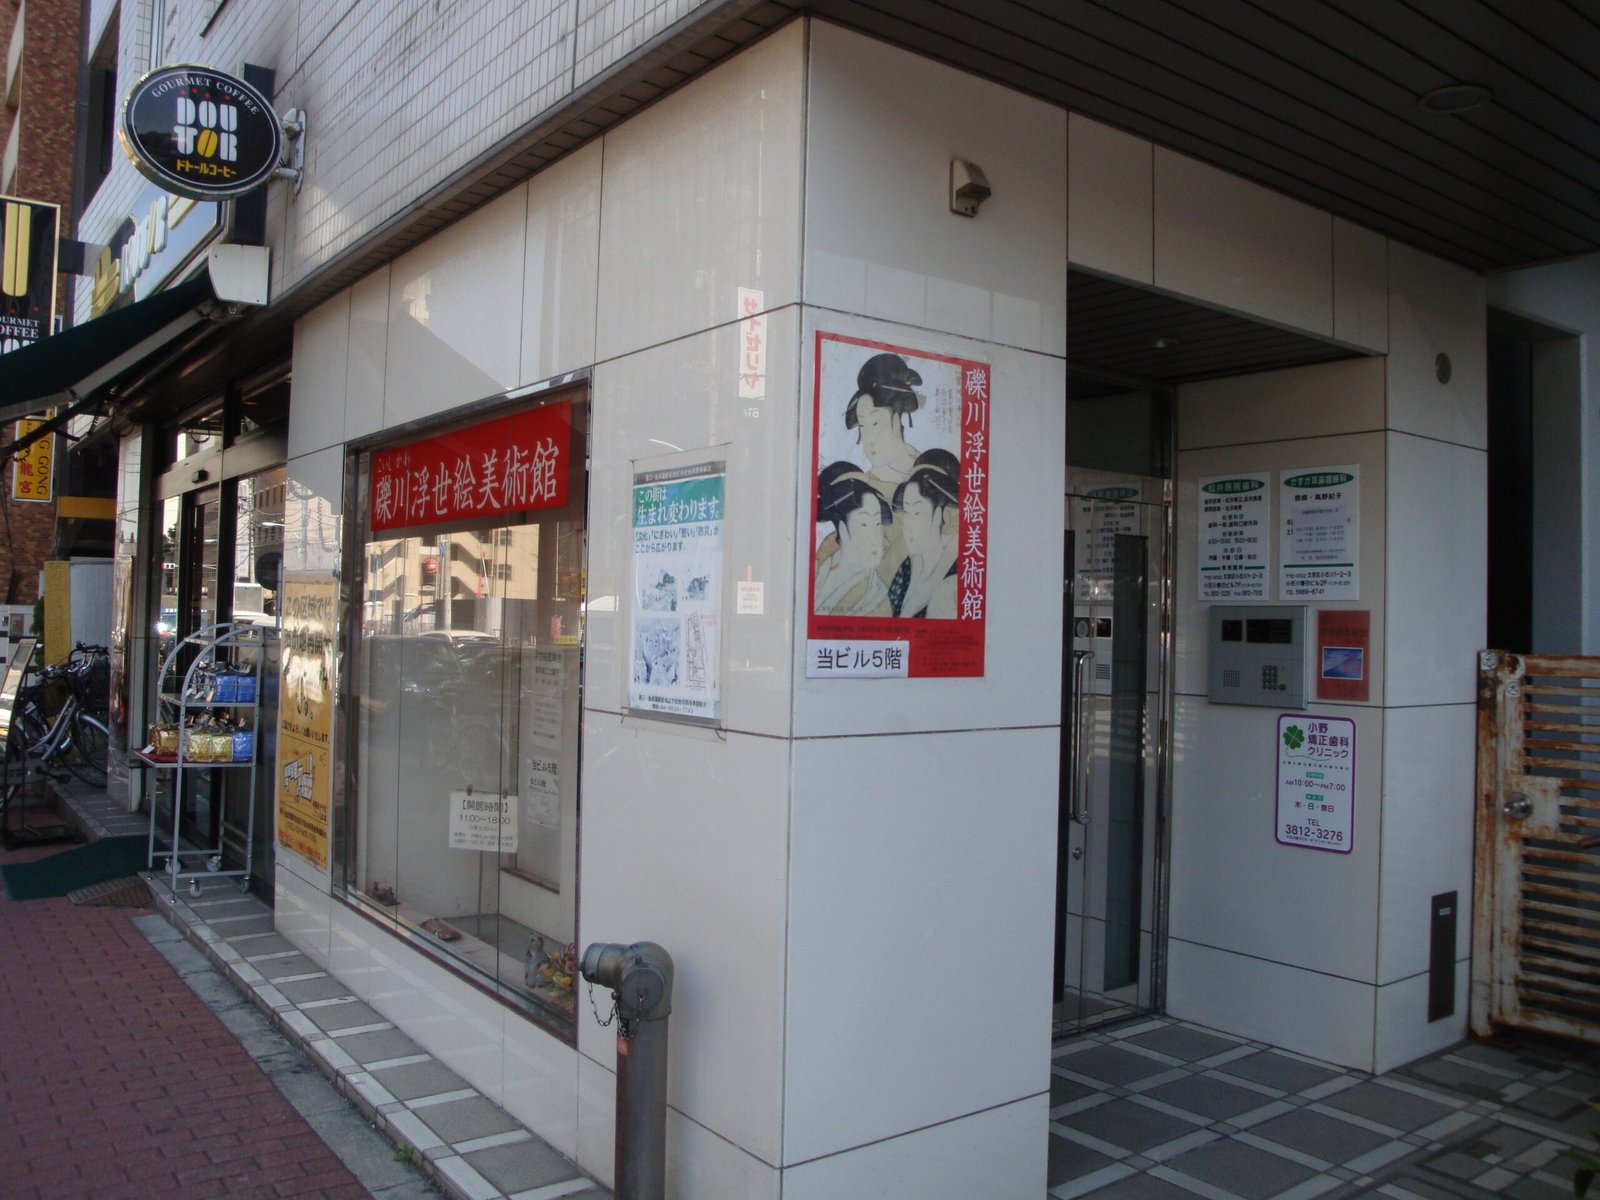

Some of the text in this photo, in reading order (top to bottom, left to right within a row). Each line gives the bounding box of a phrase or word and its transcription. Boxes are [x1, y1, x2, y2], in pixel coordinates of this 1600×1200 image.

[151, 76, 260, 115] GOURMET COFFEE
[176, 159, 238, 178] ドトールコーヒー
[375, 437, 560, 525] 礫川浮世絵美術館
[961, 368, 987, 622] 礫川浮世絵美術館
[816, 646, 902, 671] 当ビル5階
[1307, 722, 1328, 733] 小野
[1307, 735, 1350, 748] 矯正歯科
[1307, 746, 1349, 759] クリニック
[1307, 818, 1321, 827] TEL
[1285, 824, 1343, 841] 3812-3276
